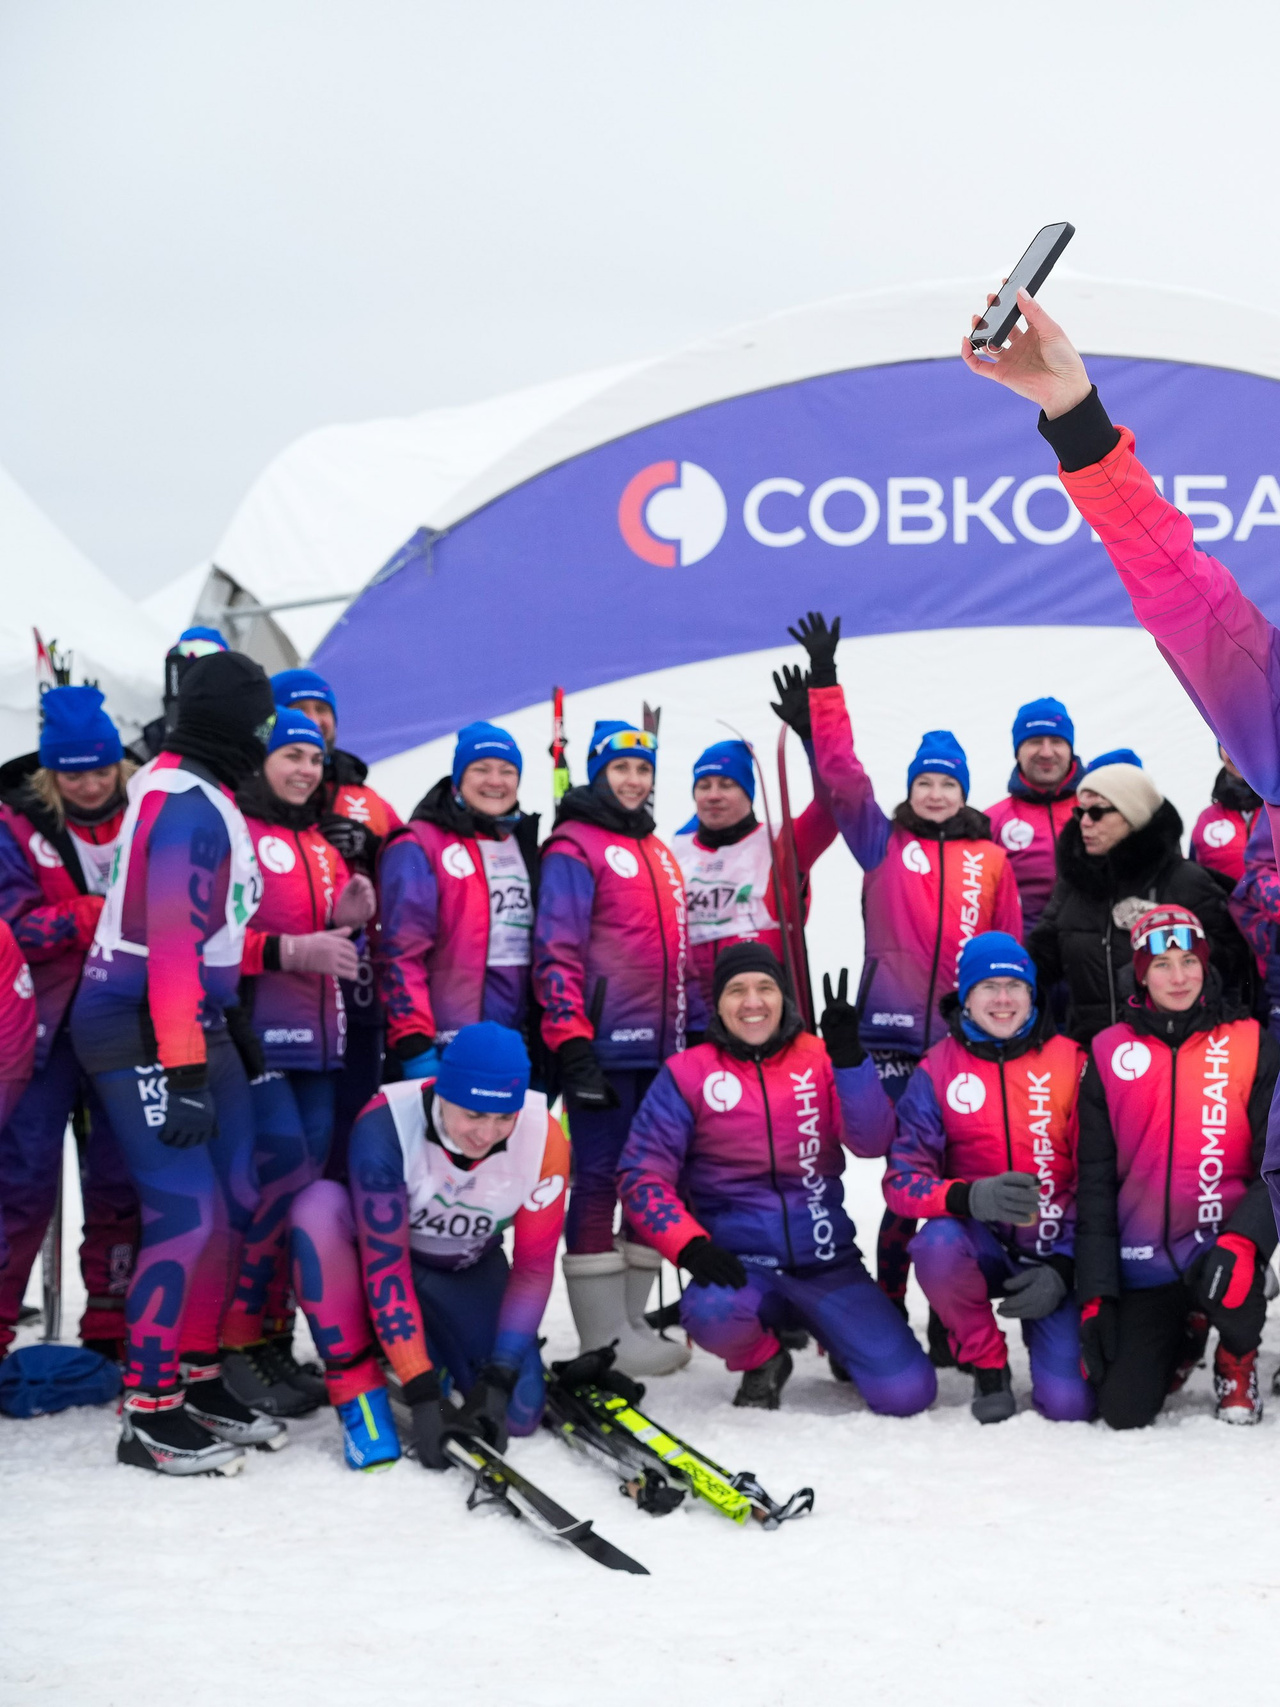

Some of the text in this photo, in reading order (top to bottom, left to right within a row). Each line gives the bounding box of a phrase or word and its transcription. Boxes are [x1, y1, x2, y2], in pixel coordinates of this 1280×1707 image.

[953, 849, 984, 987] МБАНК
[1195, 1035, 1230, 1243] ВКОМБАНК
[408, 1208, 493, 1238] 2408
